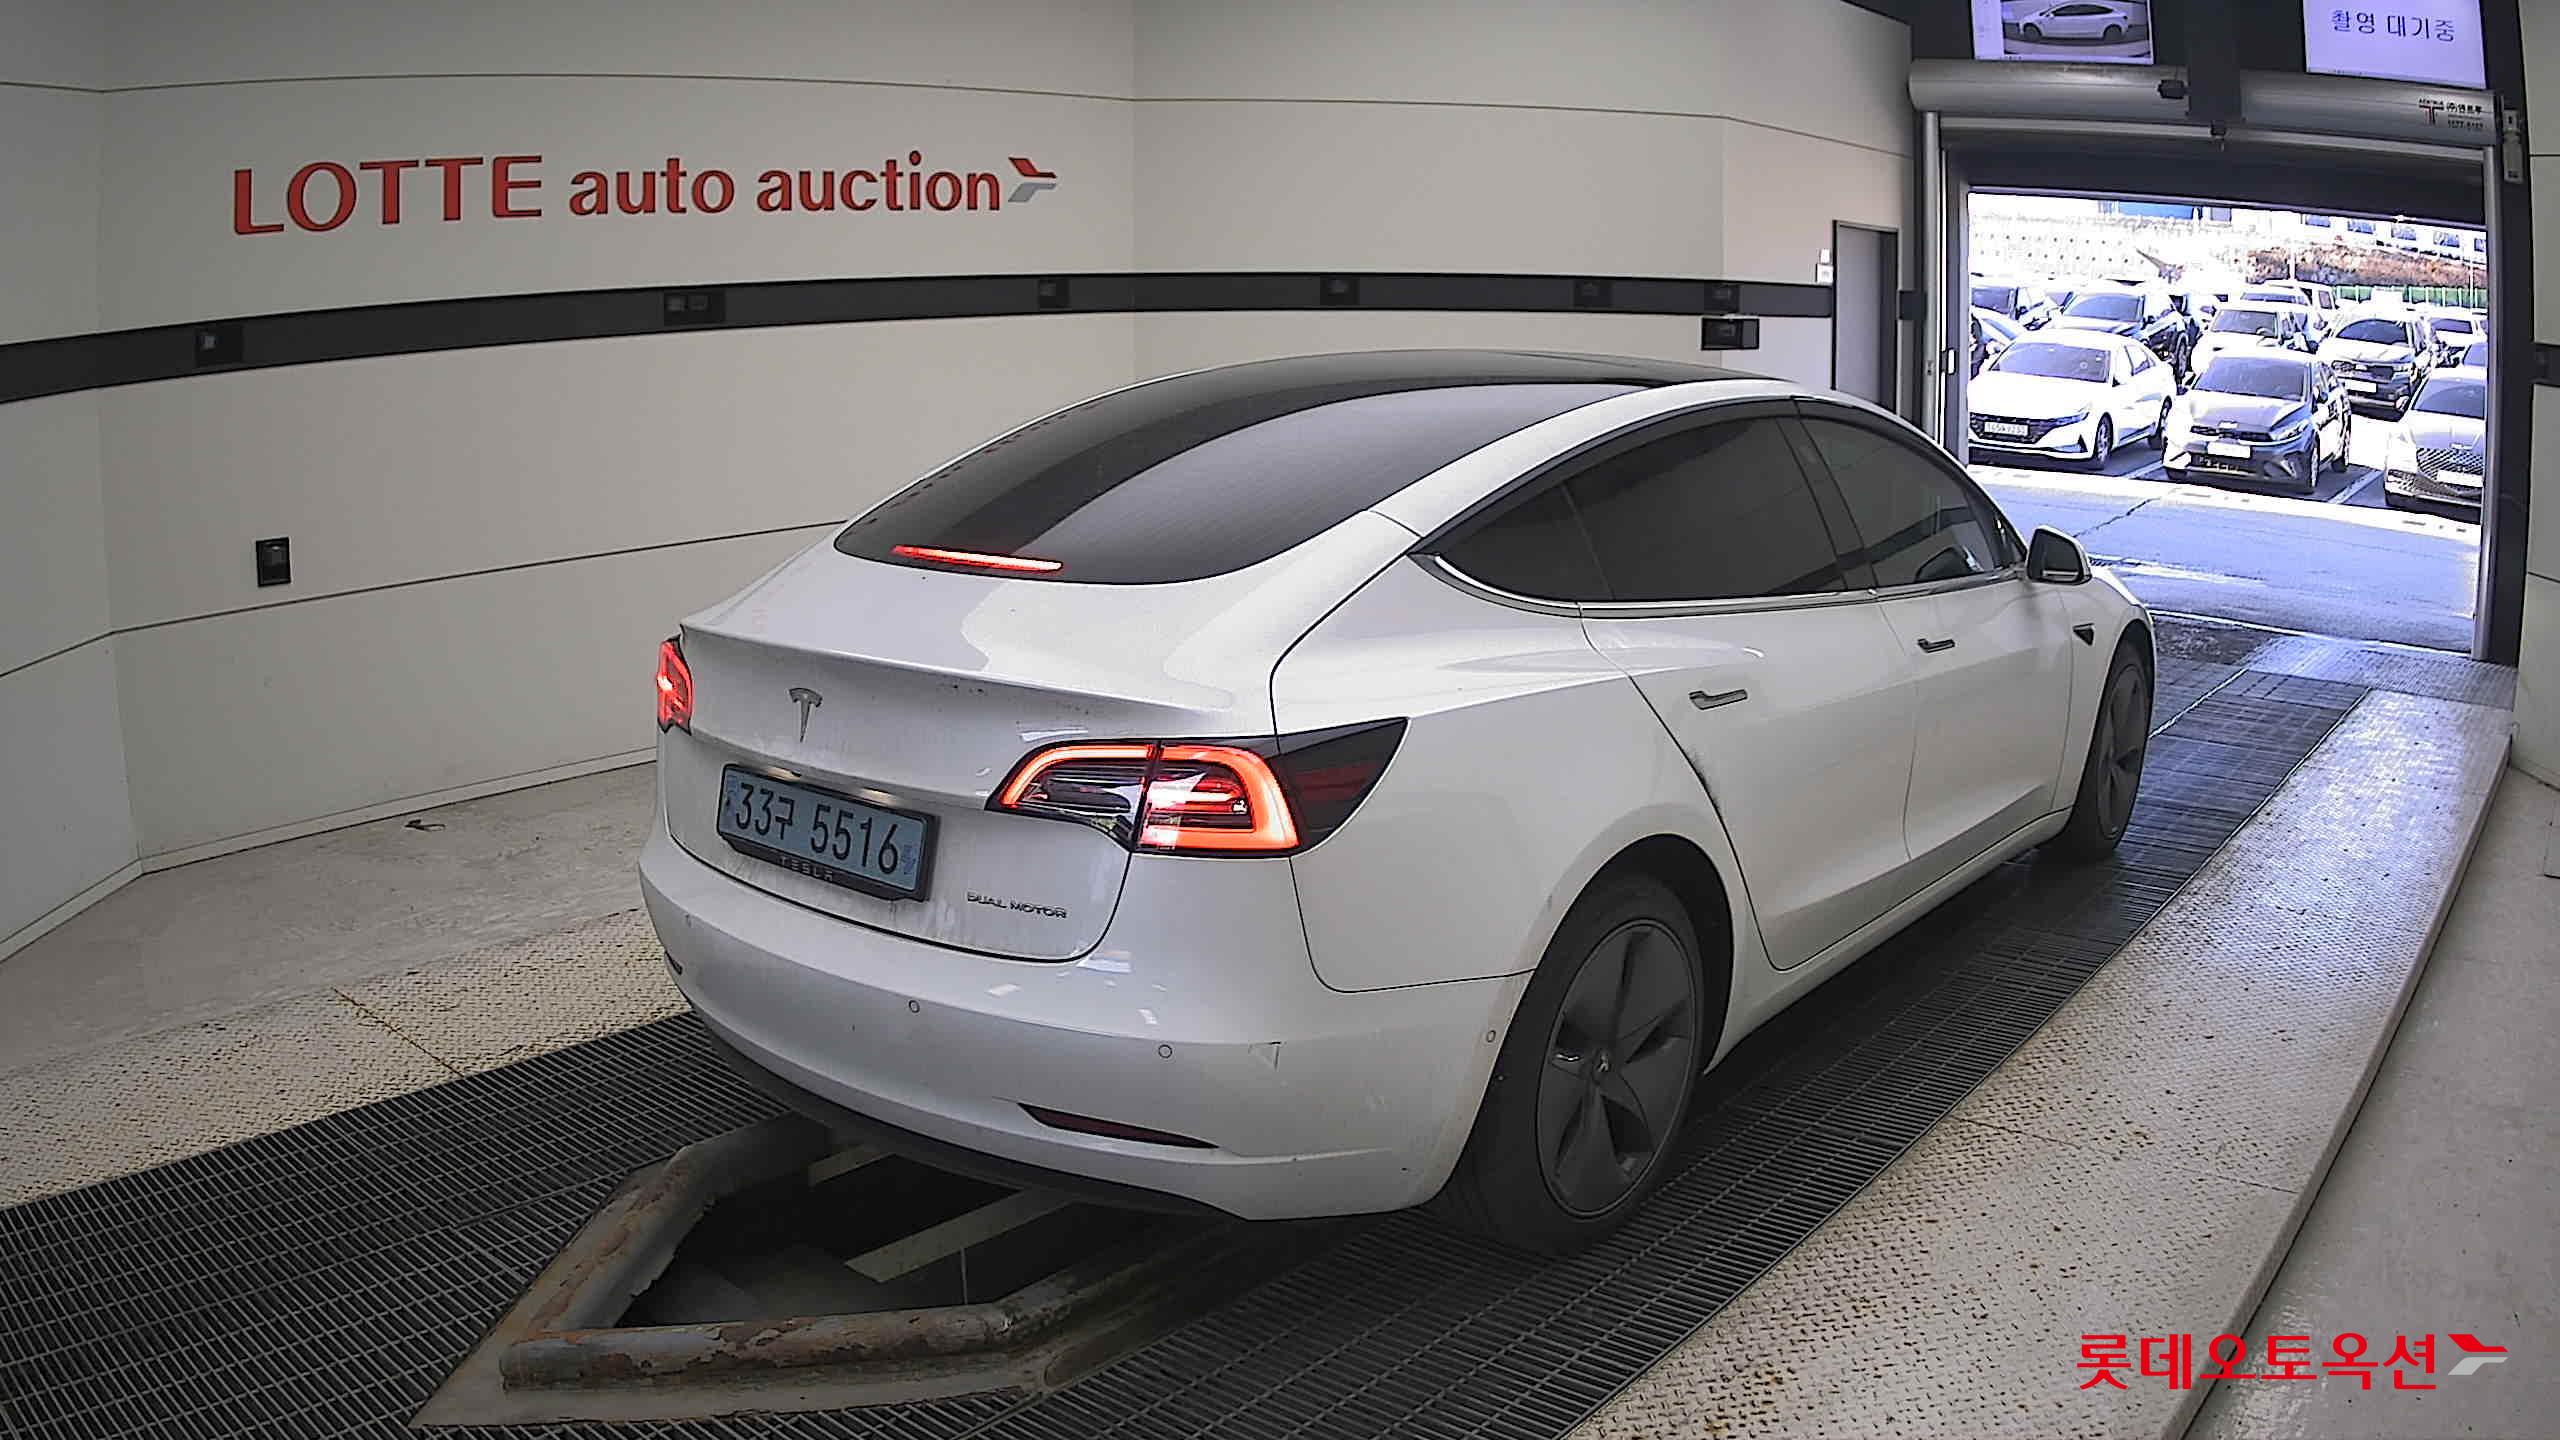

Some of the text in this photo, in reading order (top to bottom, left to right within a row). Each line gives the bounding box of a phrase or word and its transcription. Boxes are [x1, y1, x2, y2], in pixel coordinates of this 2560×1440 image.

[2332, 9, 2456, 43] 촬영 대기중
[233, 150, 1001, 236] LOTTE auto auction
[735, 781, 796, 840] 33구
[810, 803, 899, 875] 5516
[778, 854, 834, 882] TESLA
[967, 891, 1067, 919] DUAL MOTOR
